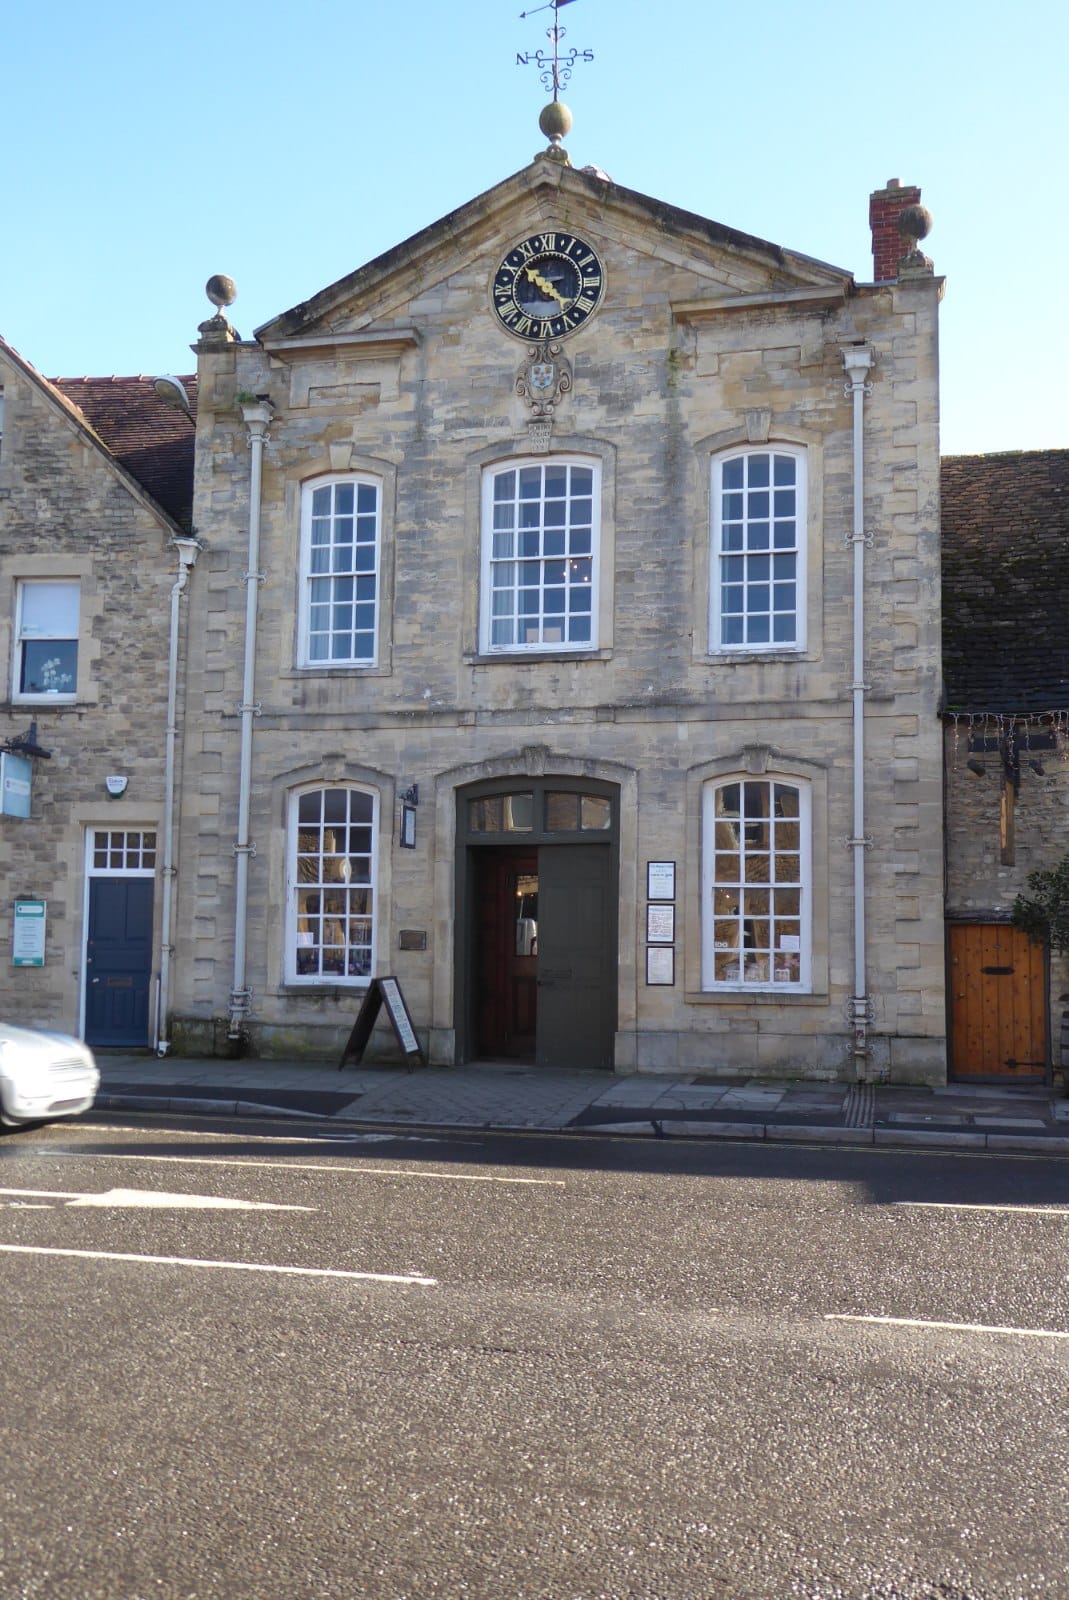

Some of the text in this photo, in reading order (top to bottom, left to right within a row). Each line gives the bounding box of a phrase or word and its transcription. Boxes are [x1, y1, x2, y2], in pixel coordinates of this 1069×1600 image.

[516, 51, 529, 65] N
[583, 49, 594, 62] S
[539, 233, 556, 251] XII
[565, 238, 576, 254] I
[518, 241, 534, 260] XI
[578, 253, 595, 267] II
[501, 261, 518, 276] X
[495, 283, 512, 296] IX
[583, 276, 600, 288] III
[498, 300, 519, 323] VIII
[575, 296, 594, 313] IIII
[514, 316, 533, 335] VII
[539, 321, 555, 337] VI
[562, 315, 576, 330] V
